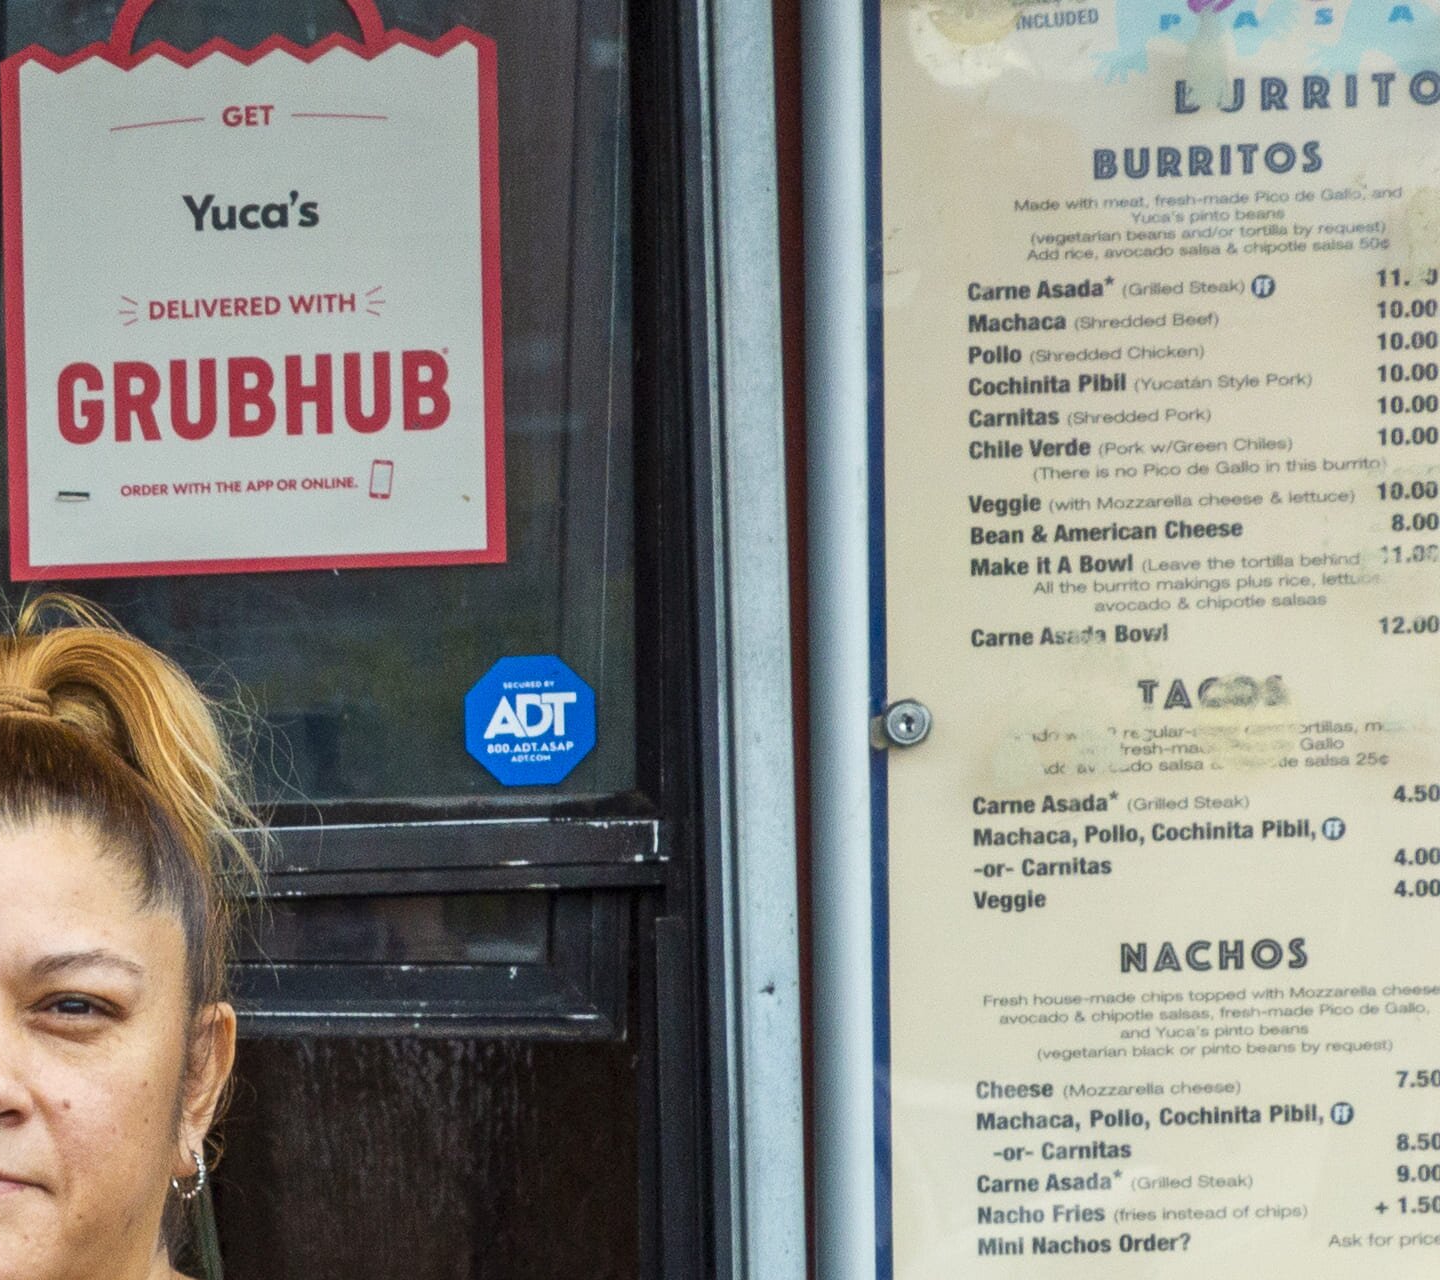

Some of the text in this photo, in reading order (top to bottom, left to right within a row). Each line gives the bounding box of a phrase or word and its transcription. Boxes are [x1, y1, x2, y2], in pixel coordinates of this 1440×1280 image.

[222, 104, 275, 128] GET
[1094, 141, 1323, 180] BURRITOS
[182, 191, 320, 232] Yuca's
[148, 293, 356, 320] DELIVERED WITH
[967, 300, 1438, 333] Machaca (Shredded Beef) 10.00
[56, 348, 452, 446] GRUBHUB
[120, 476, 358, 497] ORDER WITH THE APP OR ONLINE.
[970, 513, 1439, 546] Bean & American Cheese 8.00
[503, 681, 542, 689] SECURED
[484, 692, 576, 739] ADT
[487, 741, 574, 754] 800.ADT.ASAP
[1120, 937, 1309, 973] NACHOS
[978, 1233, 1191, 1255] Mini Nachos Order?
